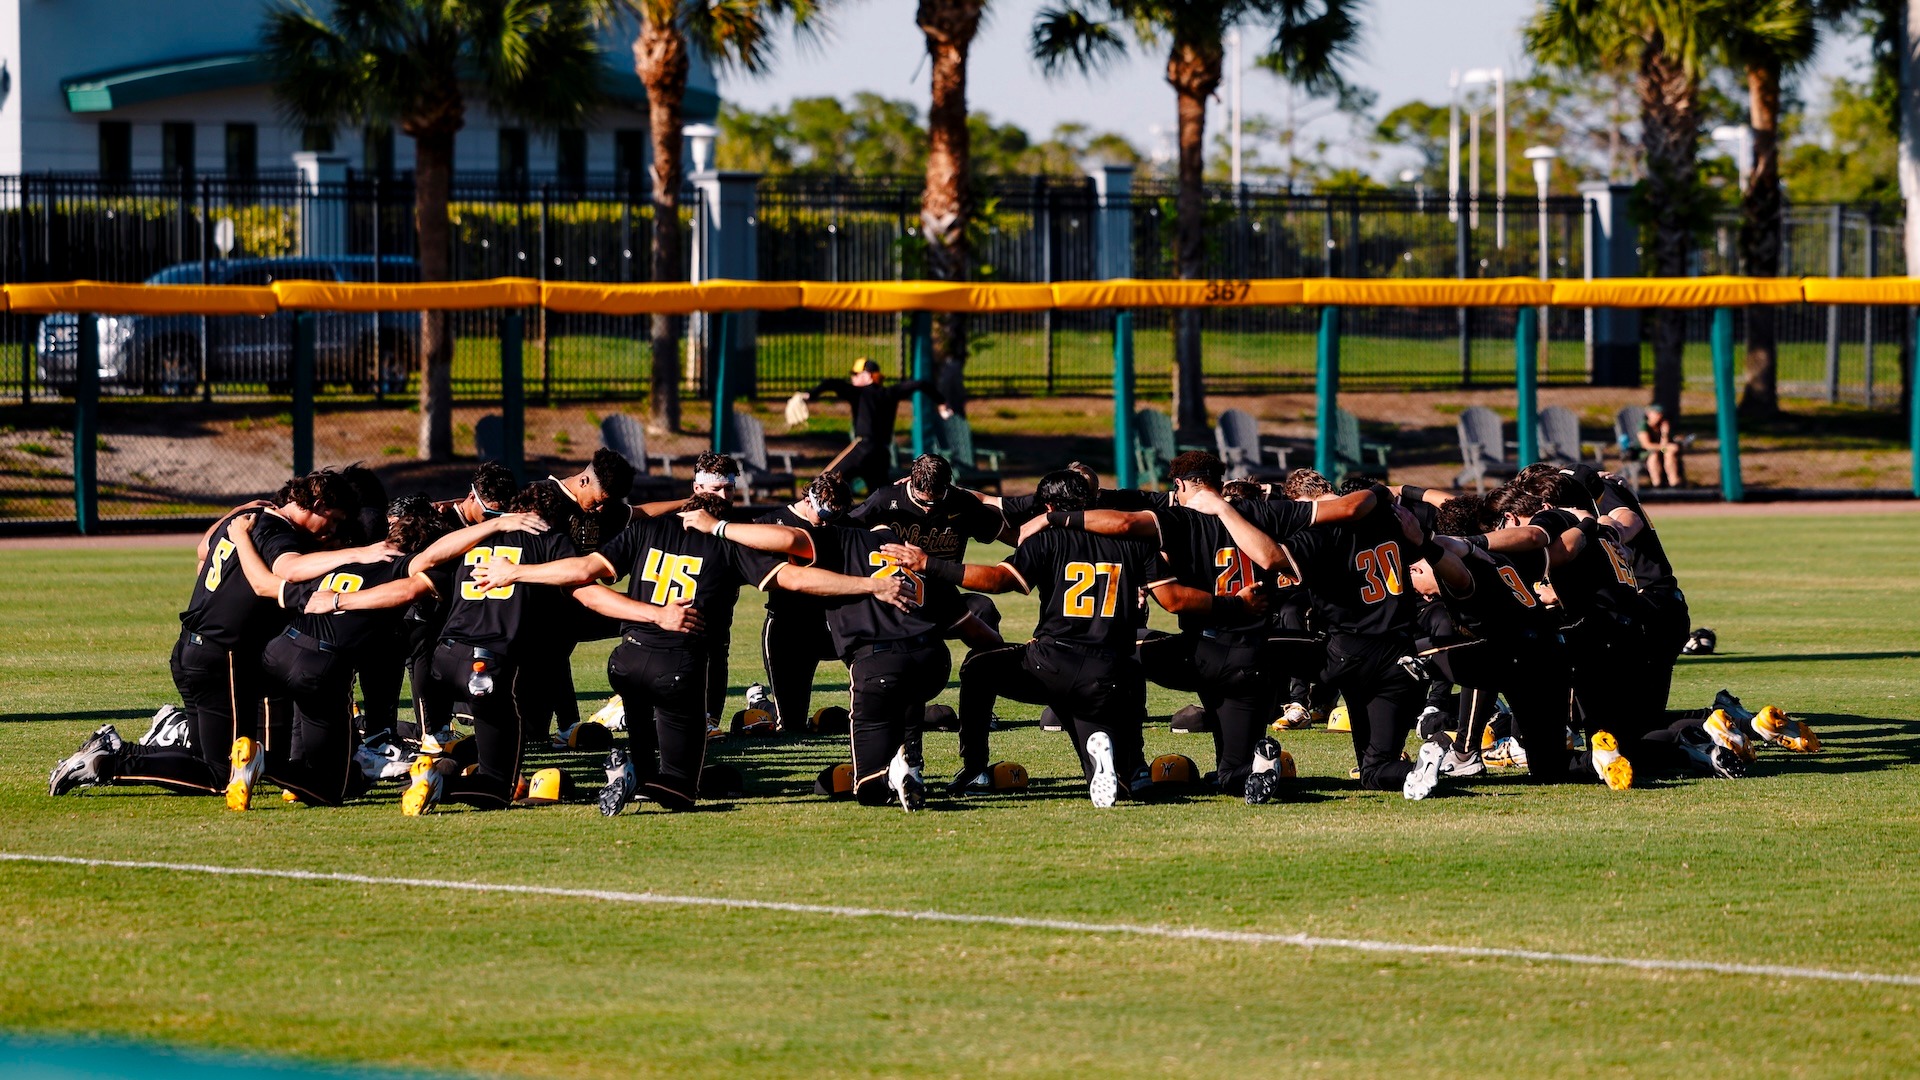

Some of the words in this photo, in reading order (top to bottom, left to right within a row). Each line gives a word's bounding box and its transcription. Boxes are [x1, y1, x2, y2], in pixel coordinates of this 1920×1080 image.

[1205, 280, 1250, 301] 367
[205, 537, 236, 592] 5
[641, 548, 703, 608] 45
[1063, 562, 1122, 618] 27
[1356, 541, 1403, 604] 30
